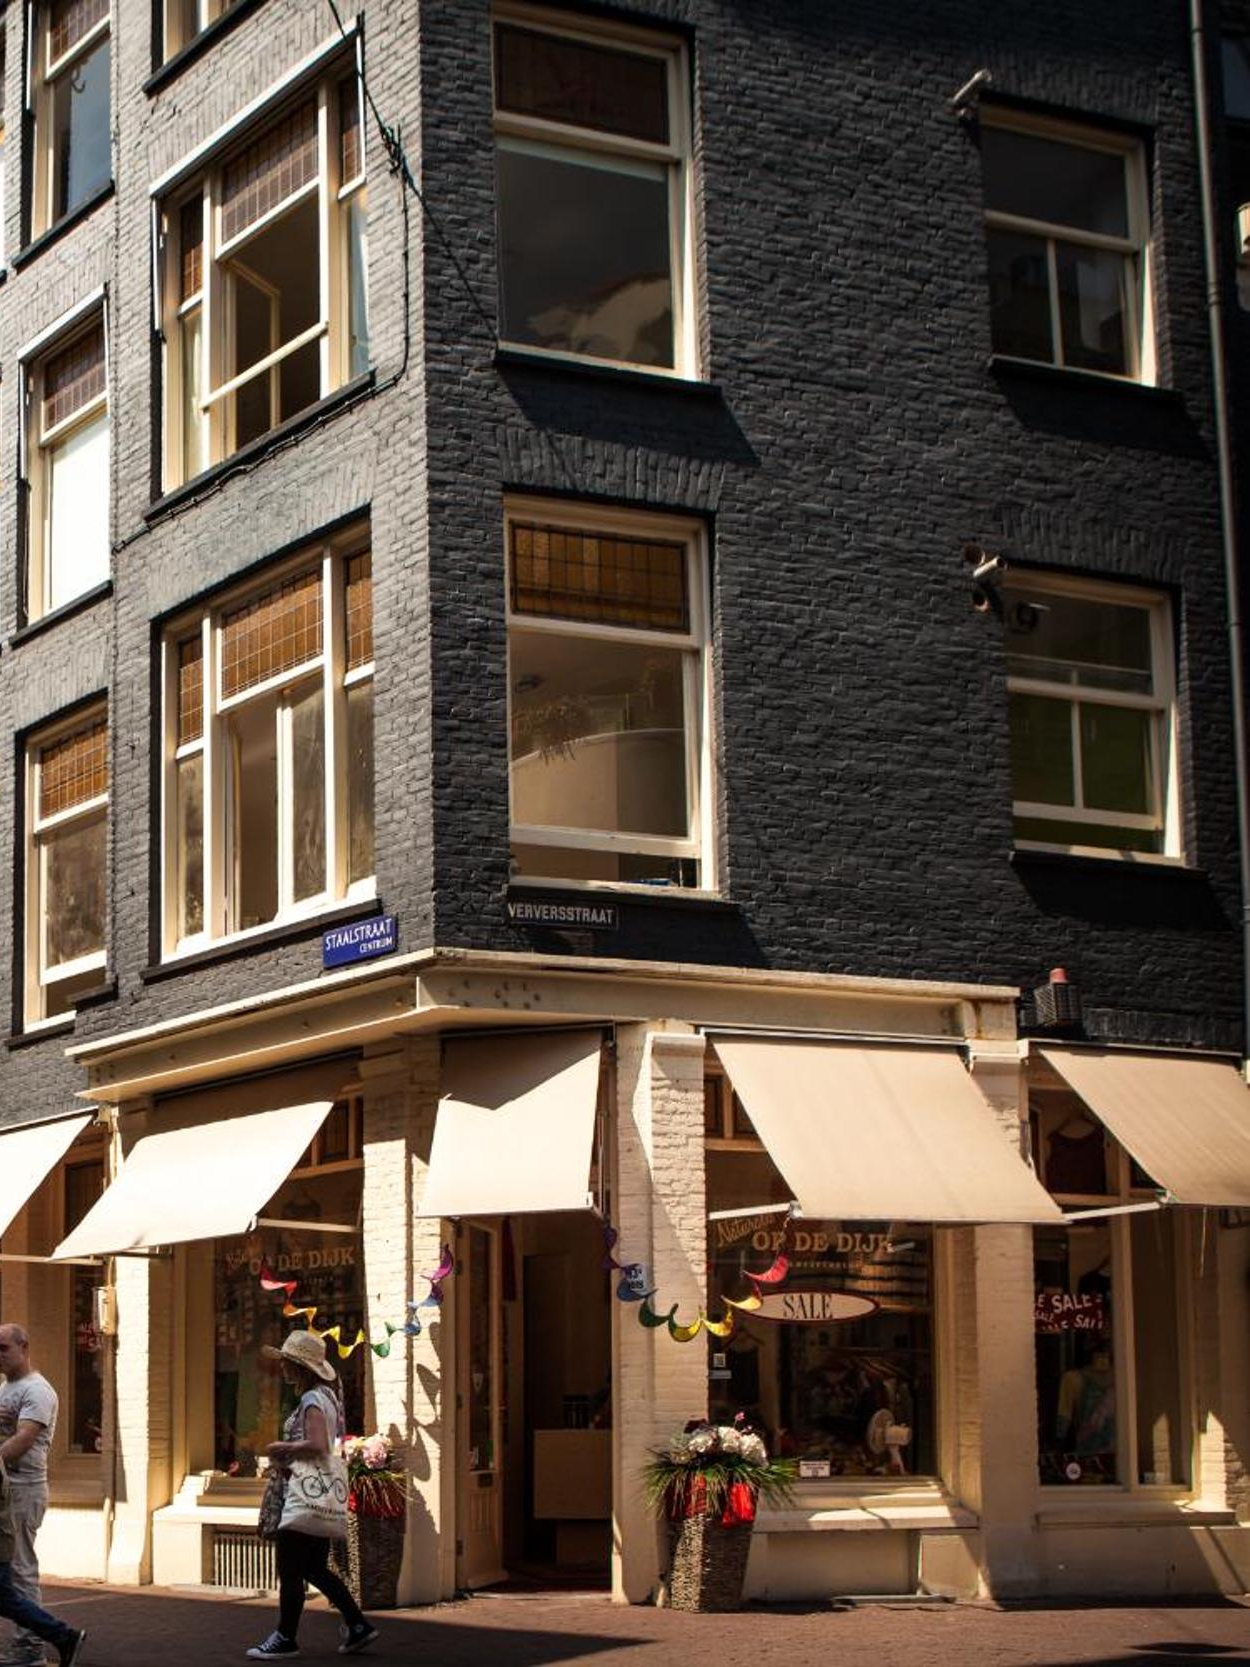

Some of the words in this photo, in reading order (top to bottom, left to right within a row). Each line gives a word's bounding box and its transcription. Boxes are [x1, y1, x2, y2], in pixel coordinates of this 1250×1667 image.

[508, 903, 614, 924] VERVERSSTRAAT
[325, 918, 392, 951] STAALSTRAAT
[360, 936, 393, 954] CENTRUM
[795, 1231, 830, 1251] DE
[836, 1232, 892, 1252] DIJK
[278, 1252, 304, 1271] DE
[309, 1246, 356, 1269] DIJK
[783, 1294, 833, 1319] SALE
[1051, 1293, 1092, 1314] SALE
